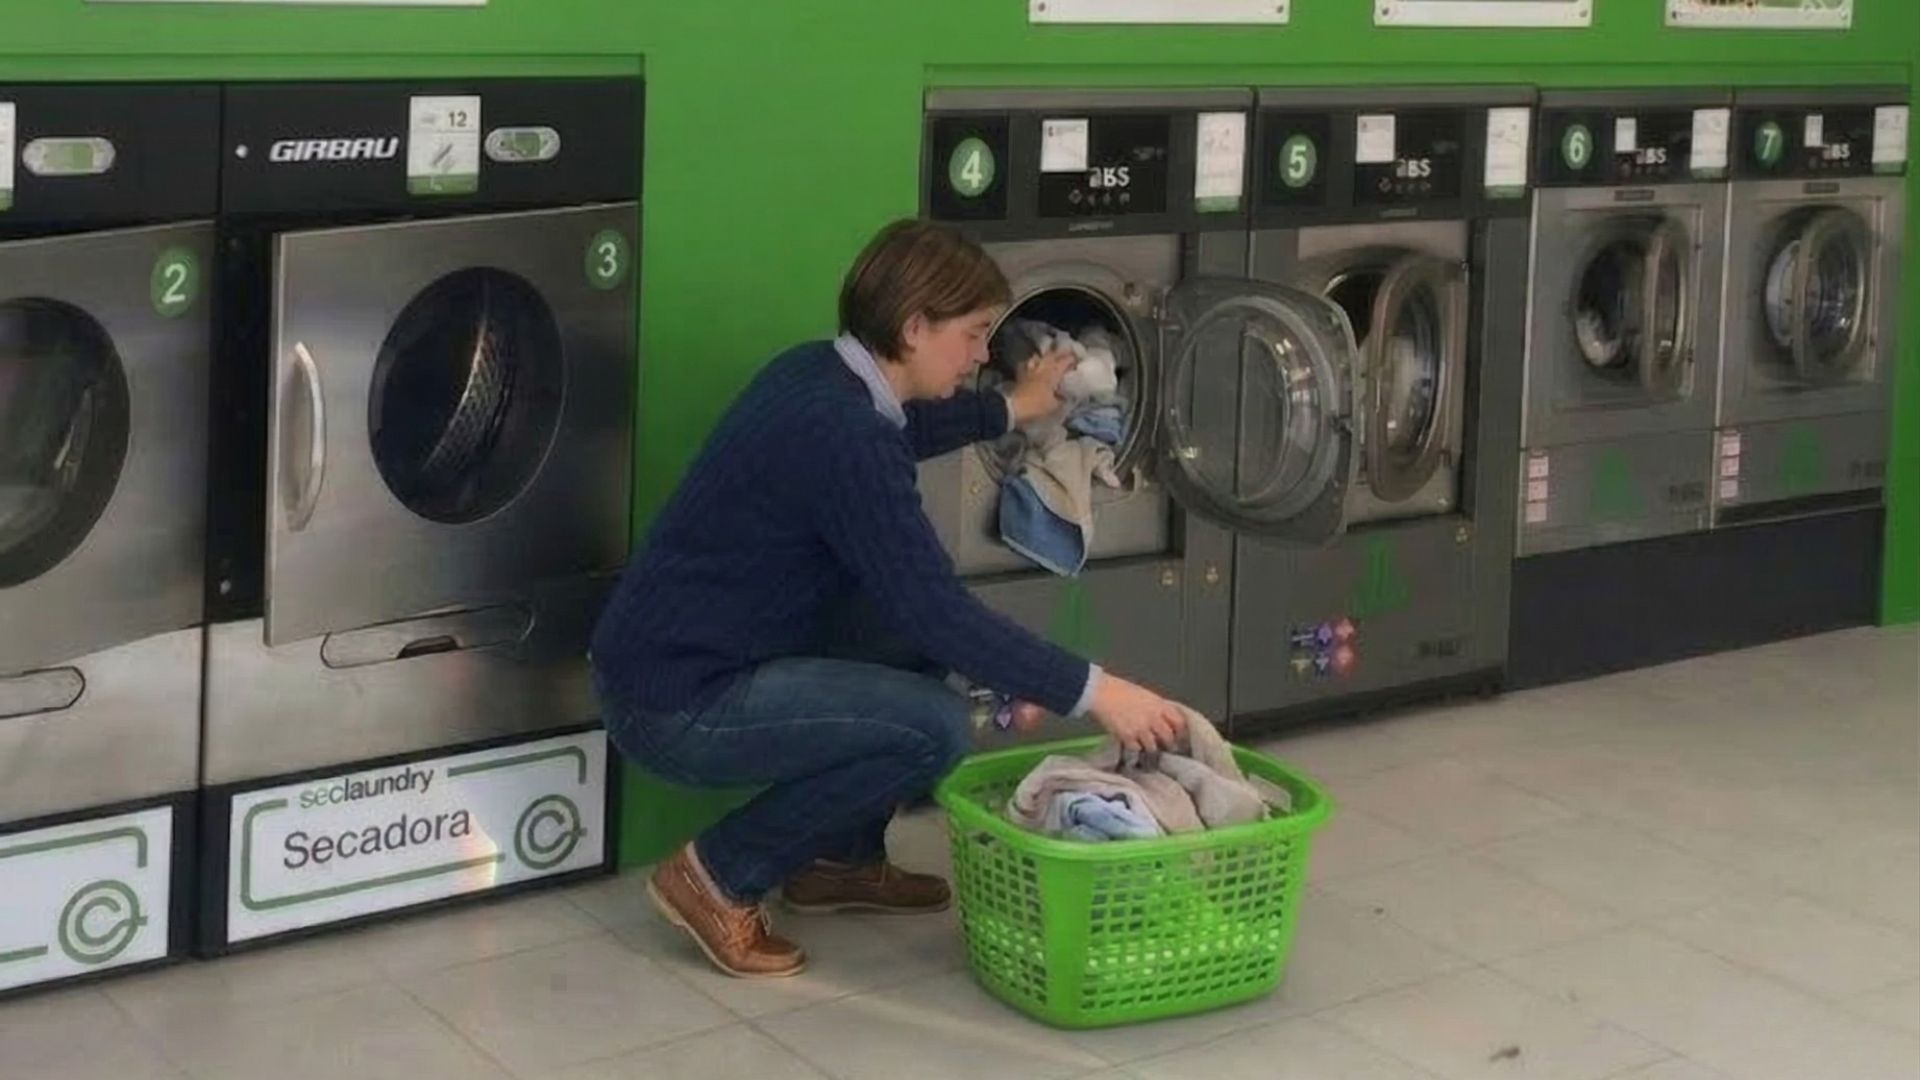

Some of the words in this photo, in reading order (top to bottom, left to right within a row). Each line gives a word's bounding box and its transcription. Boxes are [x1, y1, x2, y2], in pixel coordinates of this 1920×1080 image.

[448, 111, 468, 127] 12
[269, 137, 399, 162] GIRBAU
[1569, 131, 1585, 163] 6
[1762, 128, 1777, 160] 7
[962, 150, 983, 189] 4
[1289, 145, 1307, 179] 5
[598, 241, 617, 277] 3
[162, 263, 187, 304] 2
[299, 767, 435, 810] seclaundry
[283, 809, 471, 870] Secadora
